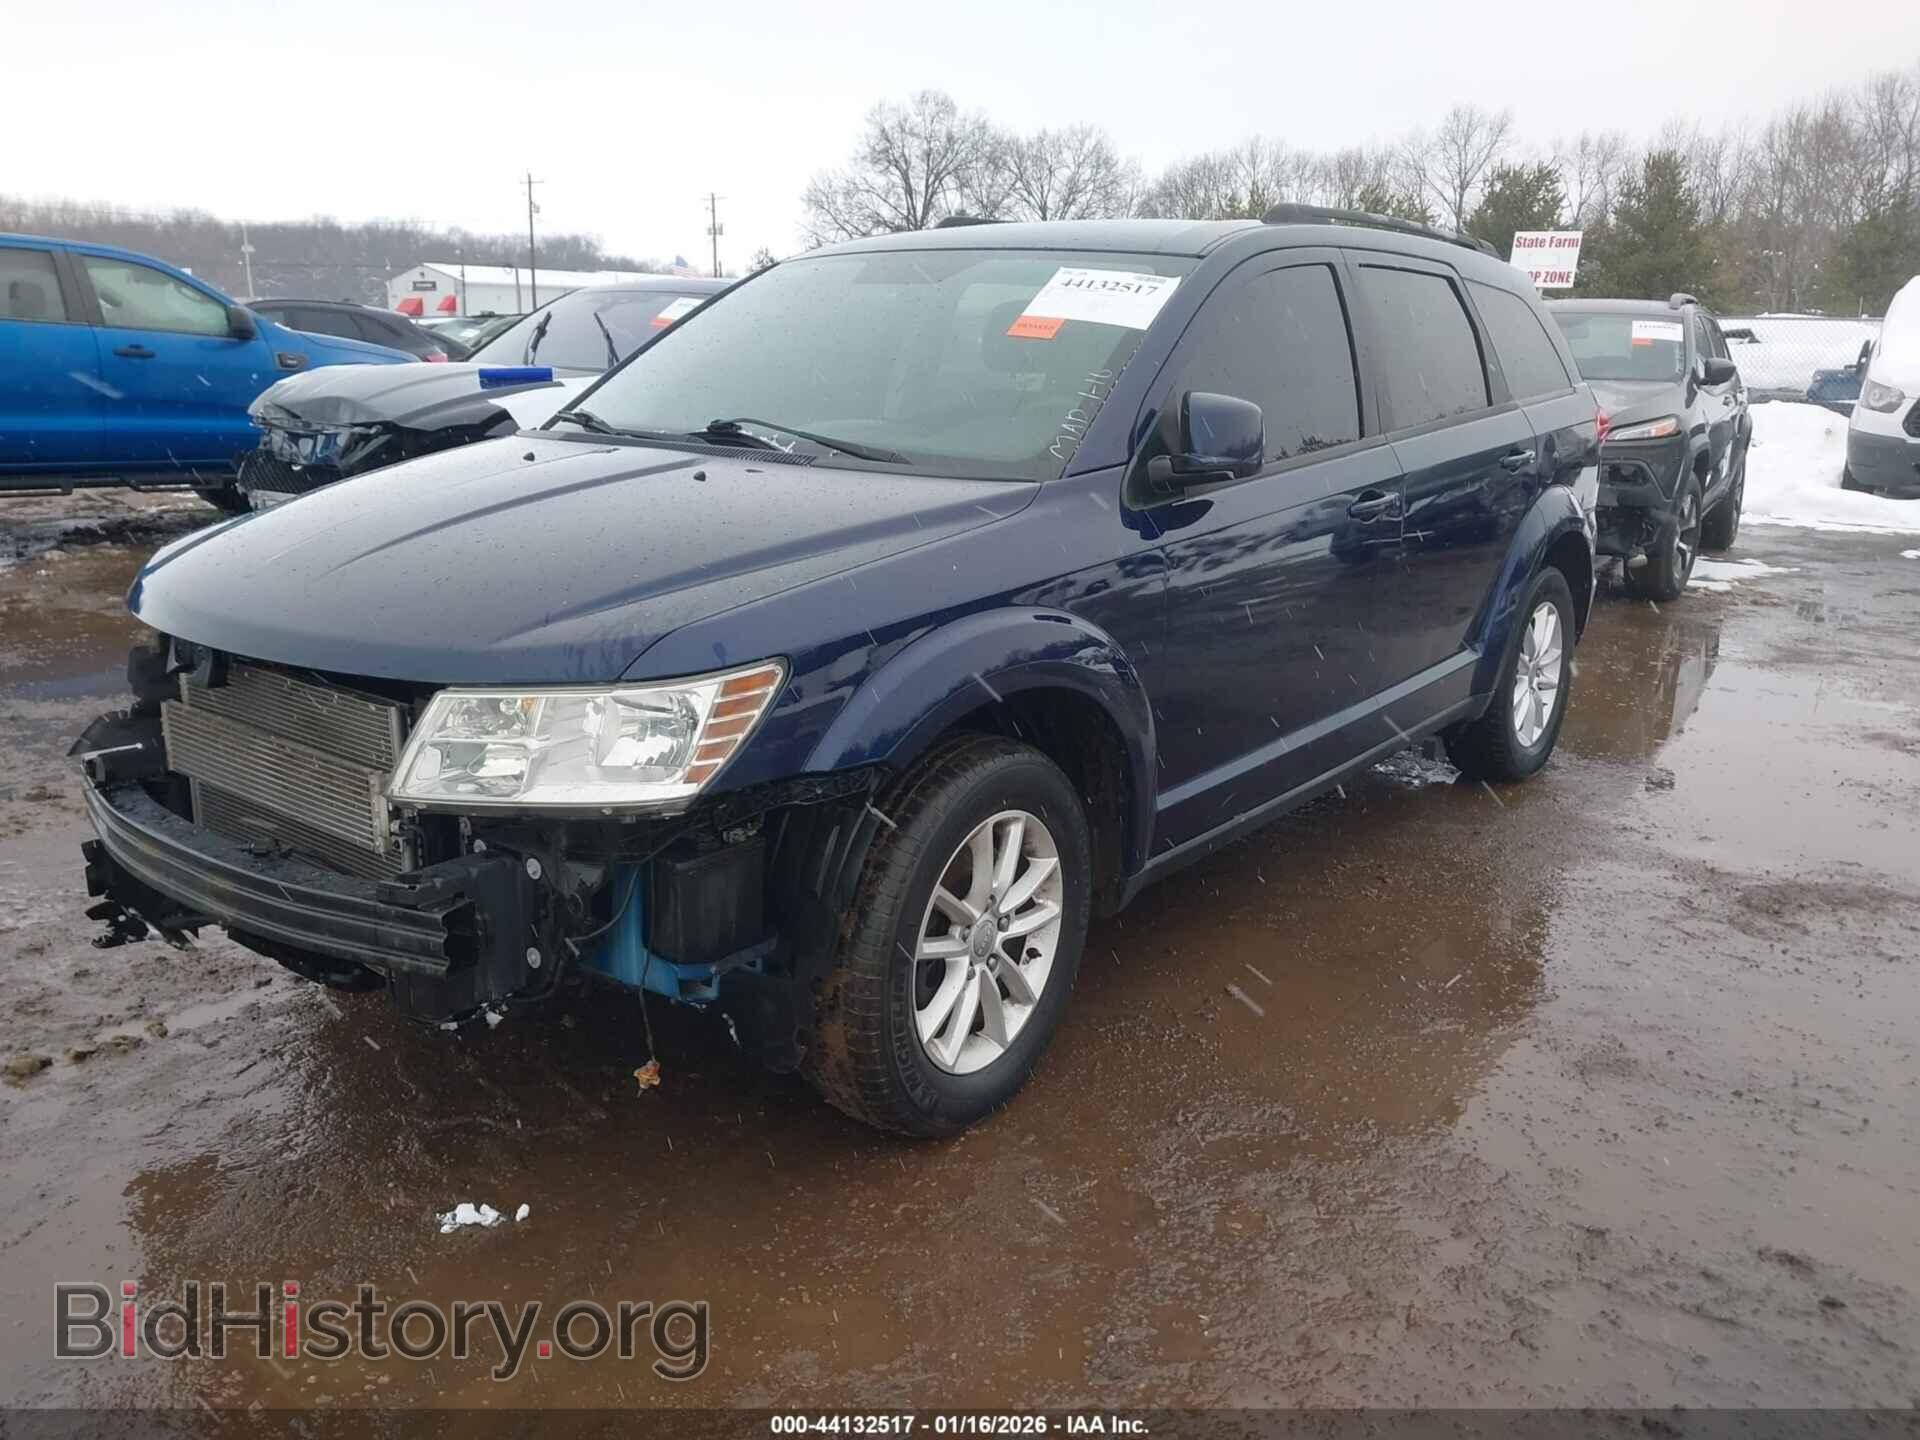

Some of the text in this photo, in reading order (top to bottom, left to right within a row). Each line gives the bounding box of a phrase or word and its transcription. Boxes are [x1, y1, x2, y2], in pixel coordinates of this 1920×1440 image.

[1515, 236, 1580, 248] State Farm
[1543, 271, 1573, 283] ZONE
[1061, 278, 1160, 296] 44132517
